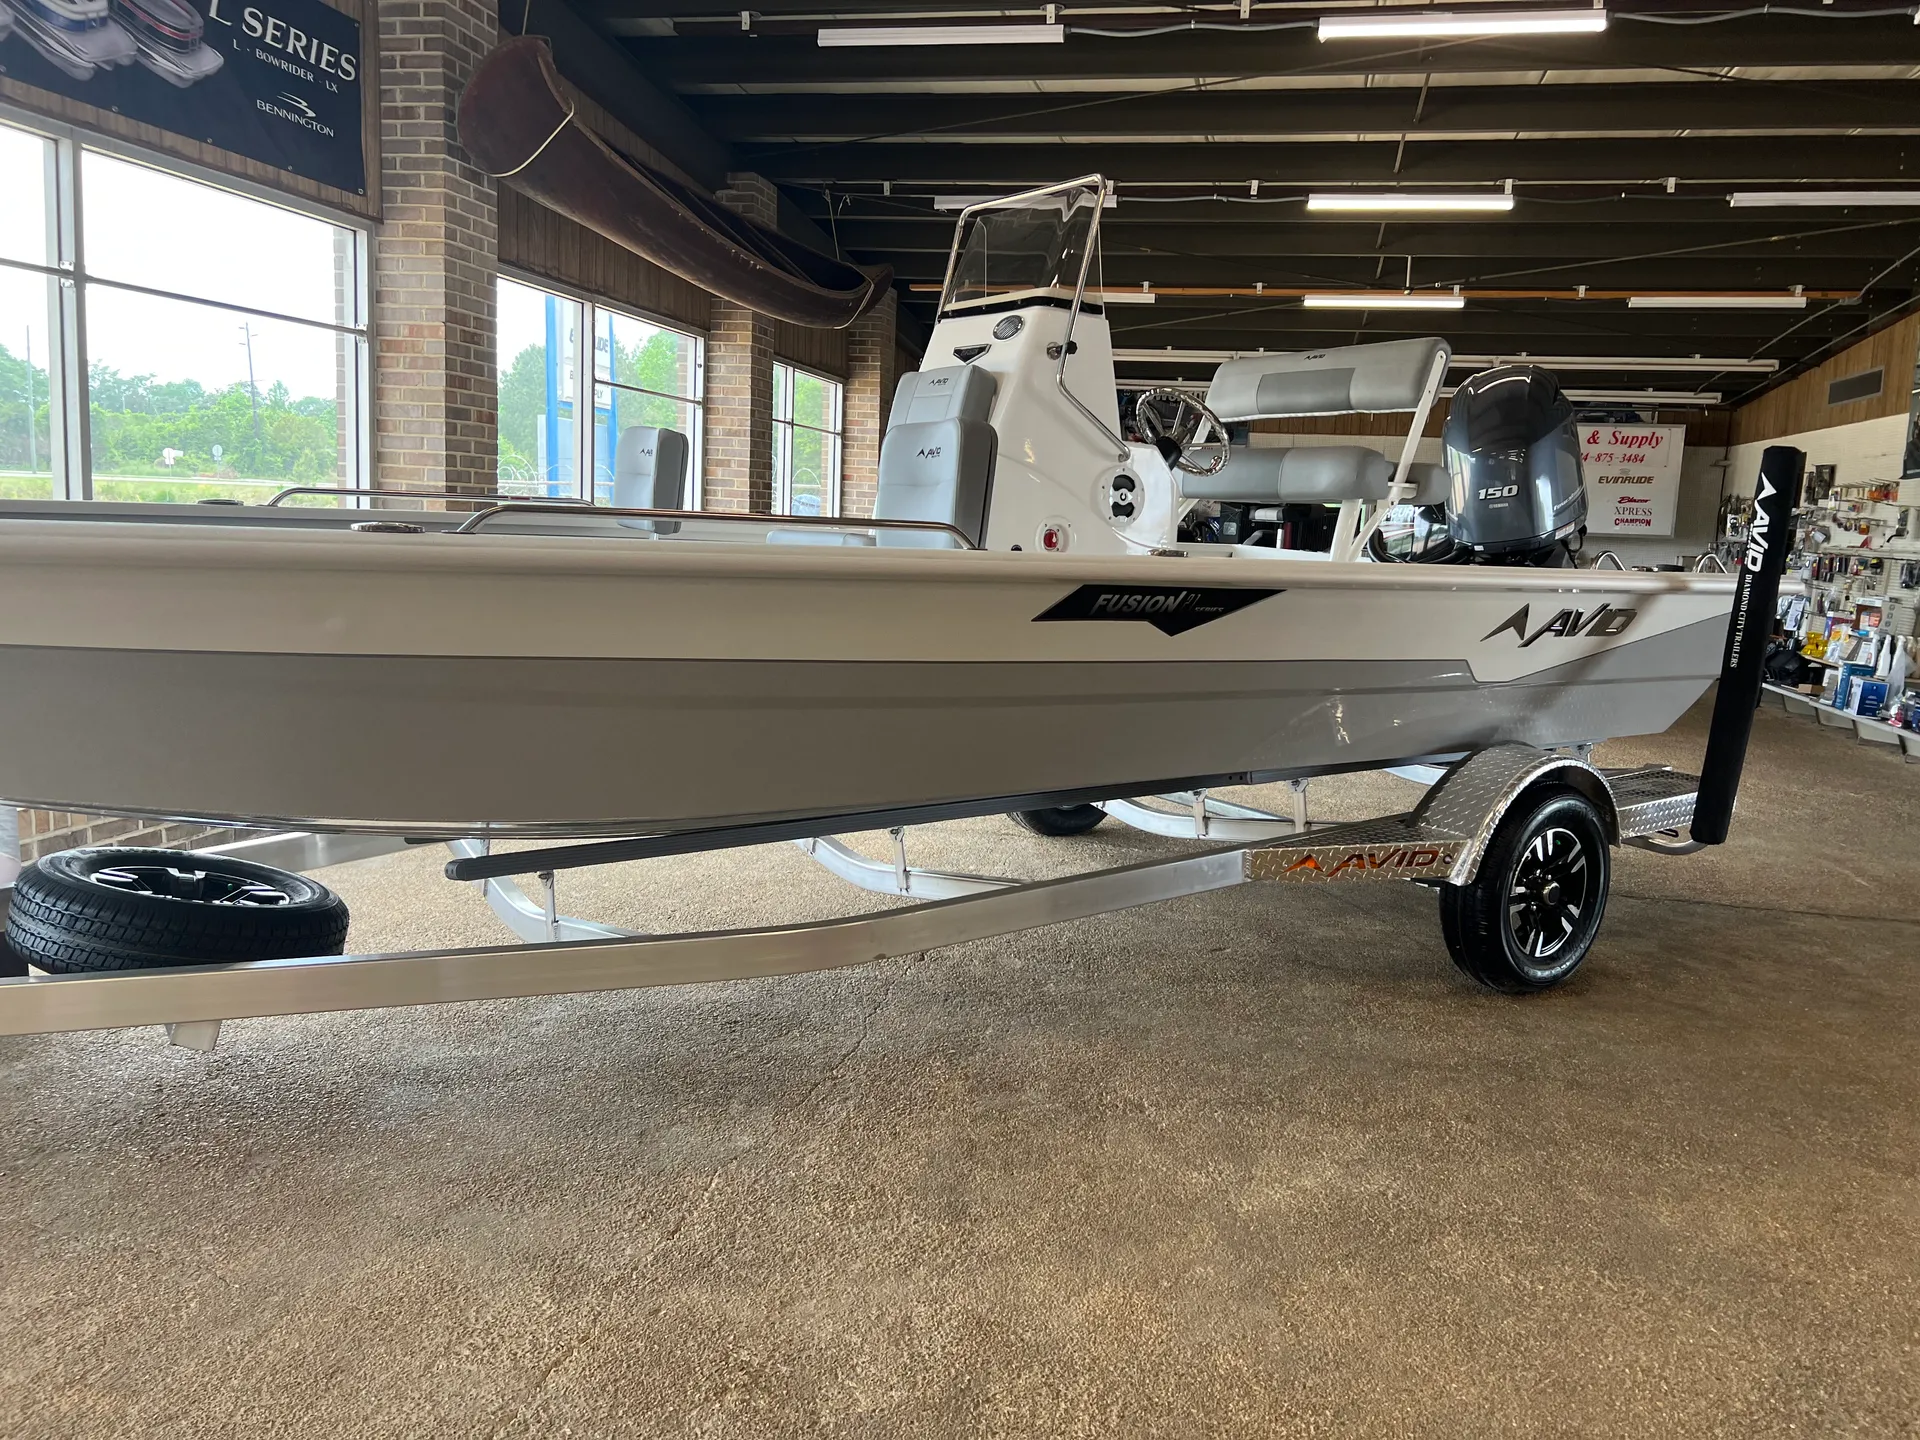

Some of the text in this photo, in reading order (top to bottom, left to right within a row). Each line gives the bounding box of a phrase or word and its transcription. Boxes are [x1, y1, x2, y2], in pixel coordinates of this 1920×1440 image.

[208, 0, 356, 81] L SERIES
[255, 48, 314, 82] BOWRIDER
[325, 80, 338, 93] LX
[256, 99, 334, 138] BENNINGTON
[1587, 430, 1663, 449] & Supply
[1478, 484, 1519, 500] 150
[1598, 475, 1654, 484] EVINRUDE
[1614, 506, 1652, 516] XPRESS
[1615, 518, 1651, 527] CHAMPION
[1747, 499, 1770, 572] AVID
[1089, 591, 1188, 615] FUSION
[1740, 574, 1753, 611] DIAMOND
[1737, 611, 1747, 631] CITY
[1730, 631, 1743, 668] TRAILERS
[1326, 848, 1439, 877] AVID
